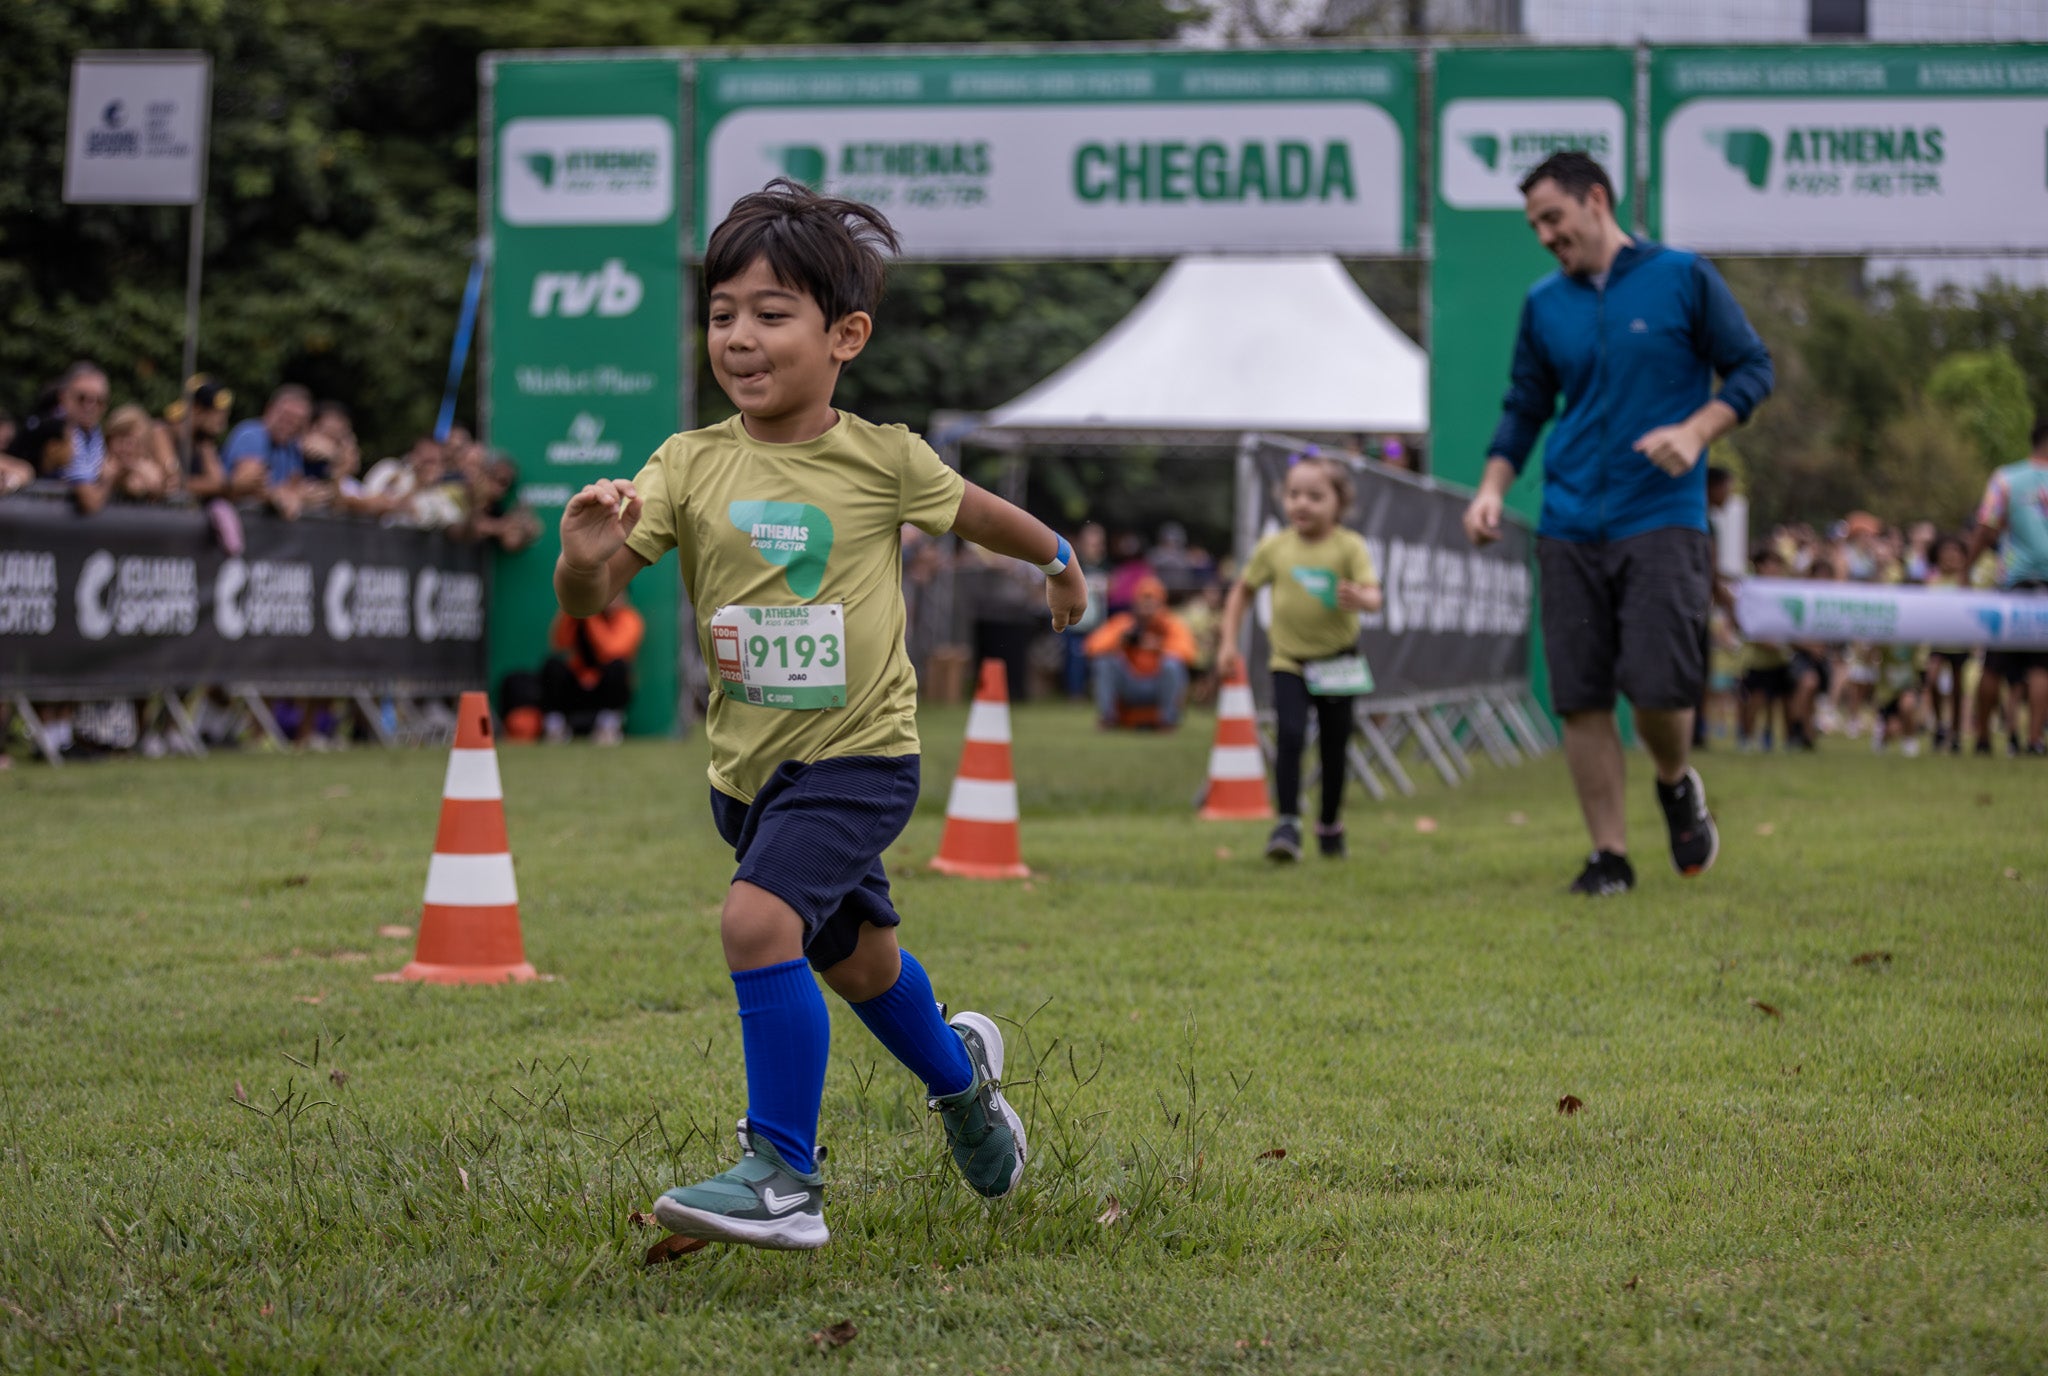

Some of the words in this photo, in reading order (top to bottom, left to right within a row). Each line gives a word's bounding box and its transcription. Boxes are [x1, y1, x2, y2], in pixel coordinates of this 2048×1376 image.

[1784, 125, 1946, 165] ATHENAS
[840, 141, 991, 176] ATHENAS
[1073, 139, 1356, 203] CHEGADA
[529, 258, 645, 318] rvb
[751, 523, 809, 541] ATHENAS
[751, 539, 773, 550] KIDS
[774, 540, 807, 552] FASTER
[764, 607, 809, 619] ATHENAS
[713, 628, 738, 638] 100m
[748, 633, 840, 669] 9193
[719, 669, 743, 682] 2020
[788, 673, 808, 681] JOAO
